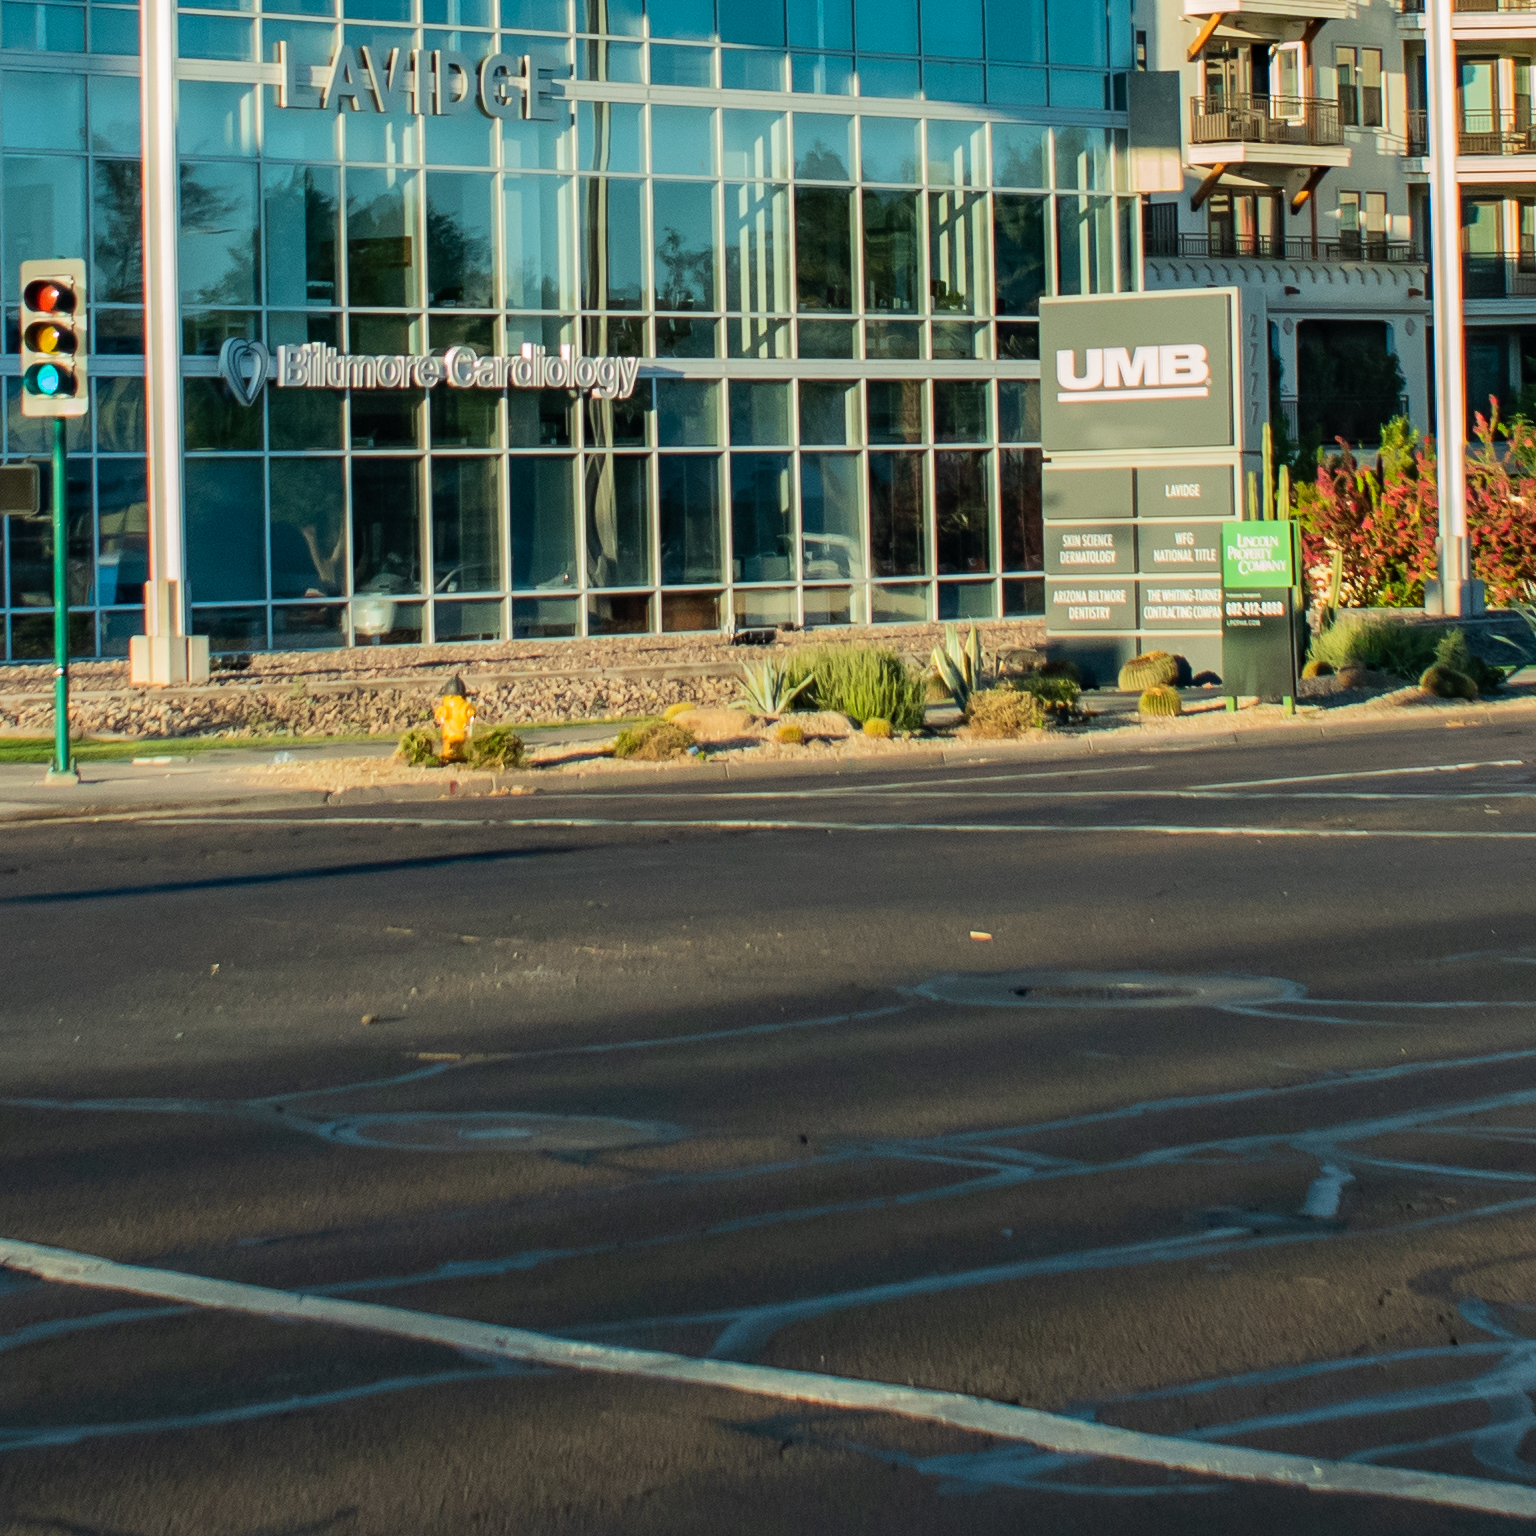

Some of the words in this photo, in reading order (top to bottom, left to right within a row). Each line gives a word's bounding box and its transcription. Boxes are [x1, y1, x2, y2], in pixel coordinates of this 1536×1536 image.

[274, 40, 562, 122] LAVIDGE
[276, 340, 441, 389] Biltmore
[444, 342, 641, 400] Cardiology
[1056, 343, 1210, 390] UMB
[1165, 483, 1201, 498] LAVIDGE
[1062, 534, 1081, 547] SKIN
[1082, 533, 1114, 547] SCIENCE
[1175, 532, 1194, 546] WFG
[1060, 550, 1116, 564] DERMATOLOGY
[1153, 549, 1194, 562] NATIONAL
[1195, 548, 1217, 562] TITLE
[1053, 590, 1087, 603] ARIZONA
[1088, 589, 1126, 603] BILTMORE
[1147, 589, 1161, 603] THE
[1068, 606, 1111, 620] DENTISTRY
[1144, 605, 1192, 620] CONTRACTING
[1193, 605, 1222, 620] COMPAN
